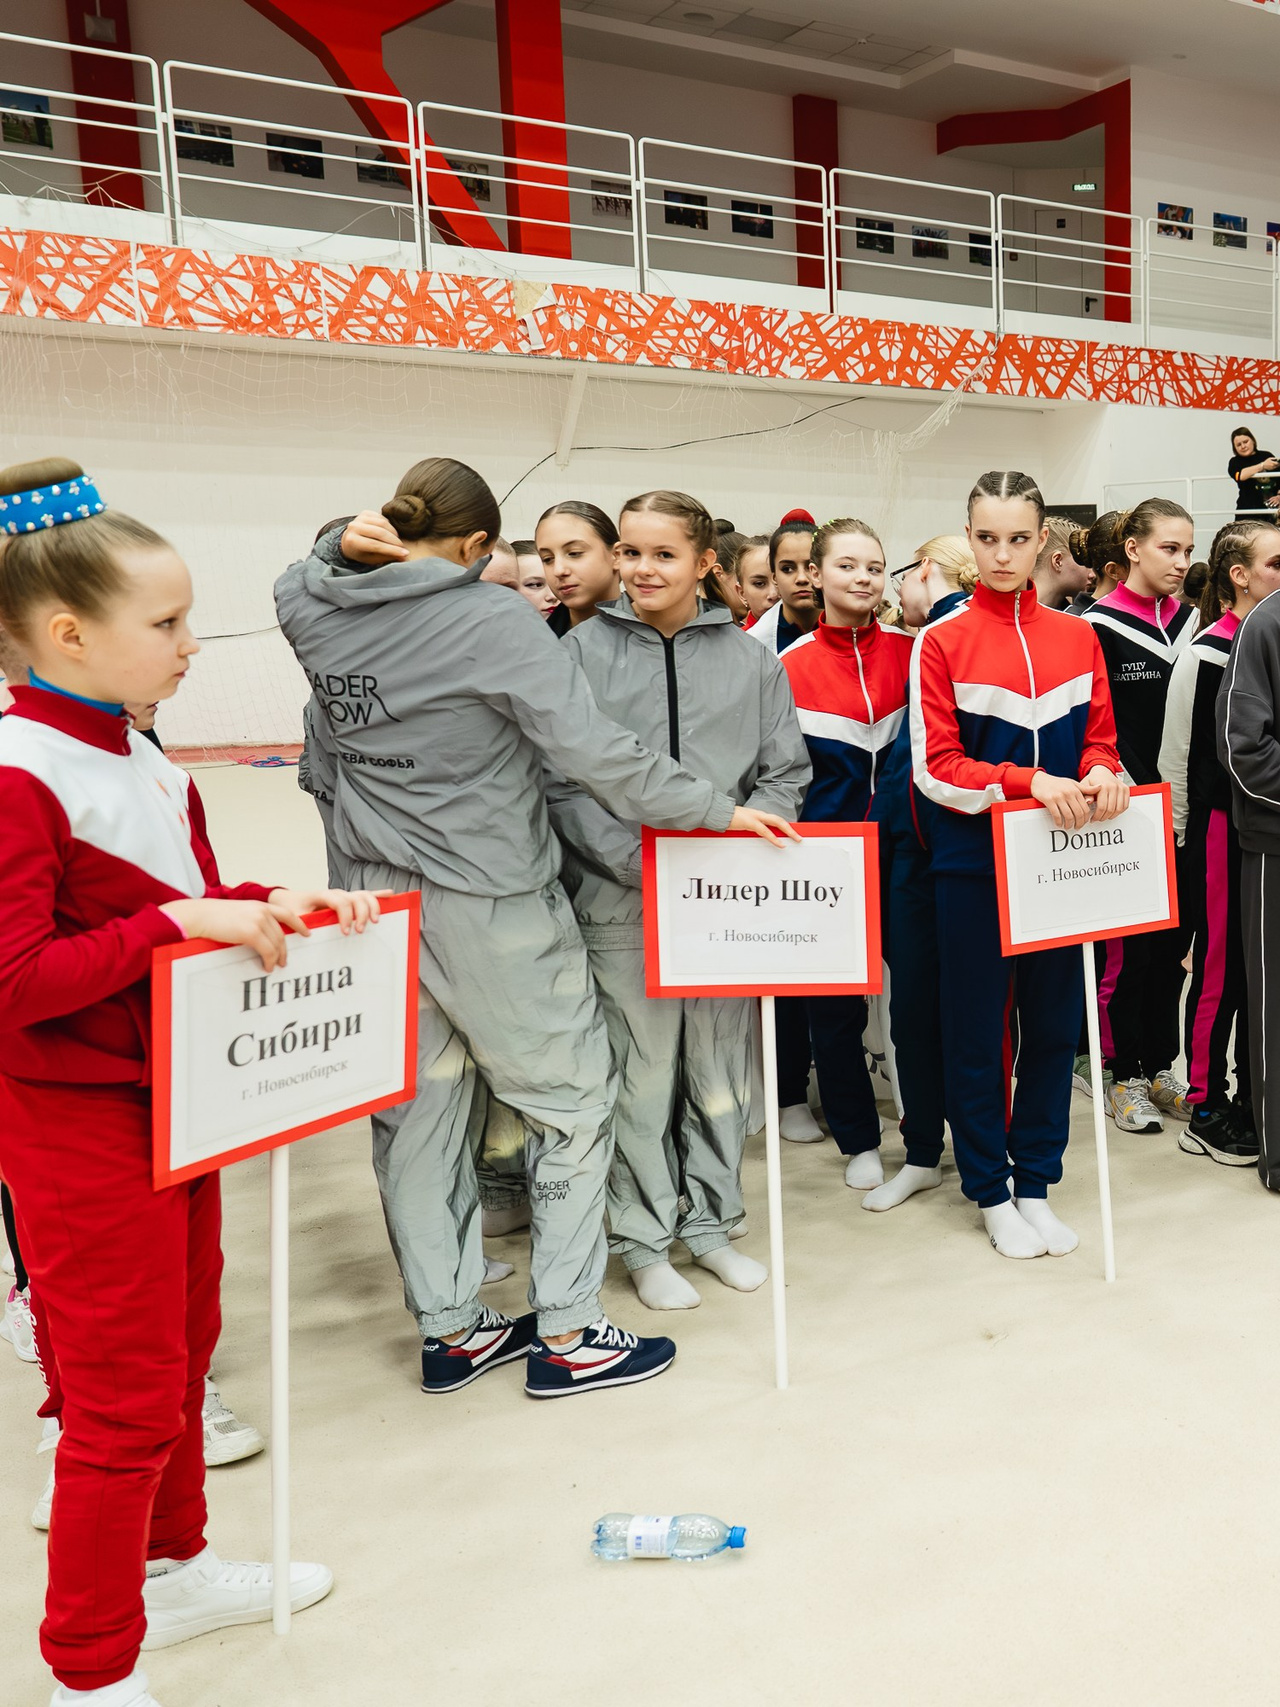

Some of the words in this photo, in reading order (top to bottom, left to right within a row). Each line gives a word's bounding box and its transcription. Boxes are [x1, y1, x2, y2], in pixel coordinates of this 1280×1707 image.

[1122, 662, 1146, 671] ГУЦУ
[369, 756, 415, 769] СОФЬЯ
[1050, 828, 1124, 853] Donna
[1037, 874, 1048, 884] г.
[1052, 860, 1140, 882] Новосибирск
[682, 877, 770, 907] Лидер
[780, 879, 843, 908] Шоу
[709, 931, 719, 942] г.
[724, 929, 818, 946] Новосибирск
[240, 965, 354, 1014] Птица
[227, 1012, 364, 1068] Сибири
[242, 1089, 252, 1101] г.
[257, 1059, 349, 1097] Новосибирск
[537, 1190, 567, 1208] SHOW
